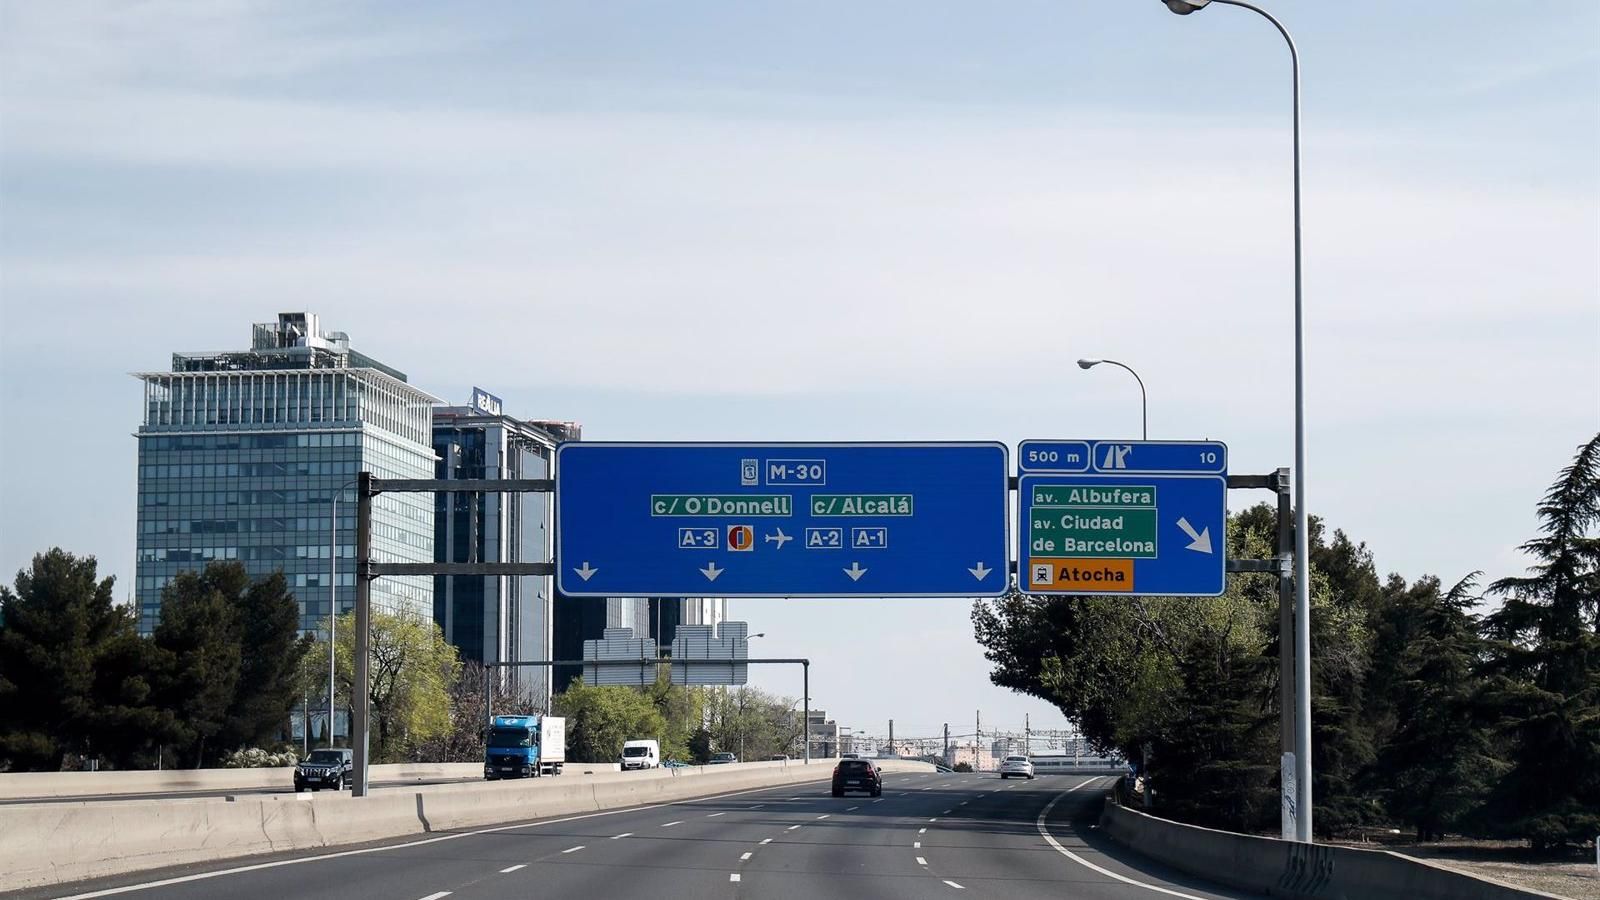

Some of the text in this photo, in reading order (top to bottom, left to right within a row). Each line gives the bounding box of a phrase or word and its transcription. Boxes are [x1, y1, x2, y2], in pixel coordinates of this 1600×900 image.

[1029, 451, 1080, 463] 500 m
[1200, 452, 1216, 464] 10
[771, 465, 822, 480] M-30
[1035, 489, 1151, 504] av. Albufera
[655, 497, 789, 514] c/ O'Donnell
[814, 497, 909, 514] c/ Alcalá
[1034, 515, 1124, 530] av. Ciudad
[682, 530, 715, 545] A-3
[809, 531, 839, 545] A-2
[856, 531, 884, 545] A-1
[1033, 538, 1154, 553] de Barcelona
[1058, 567, 1125, 582] Atocha
